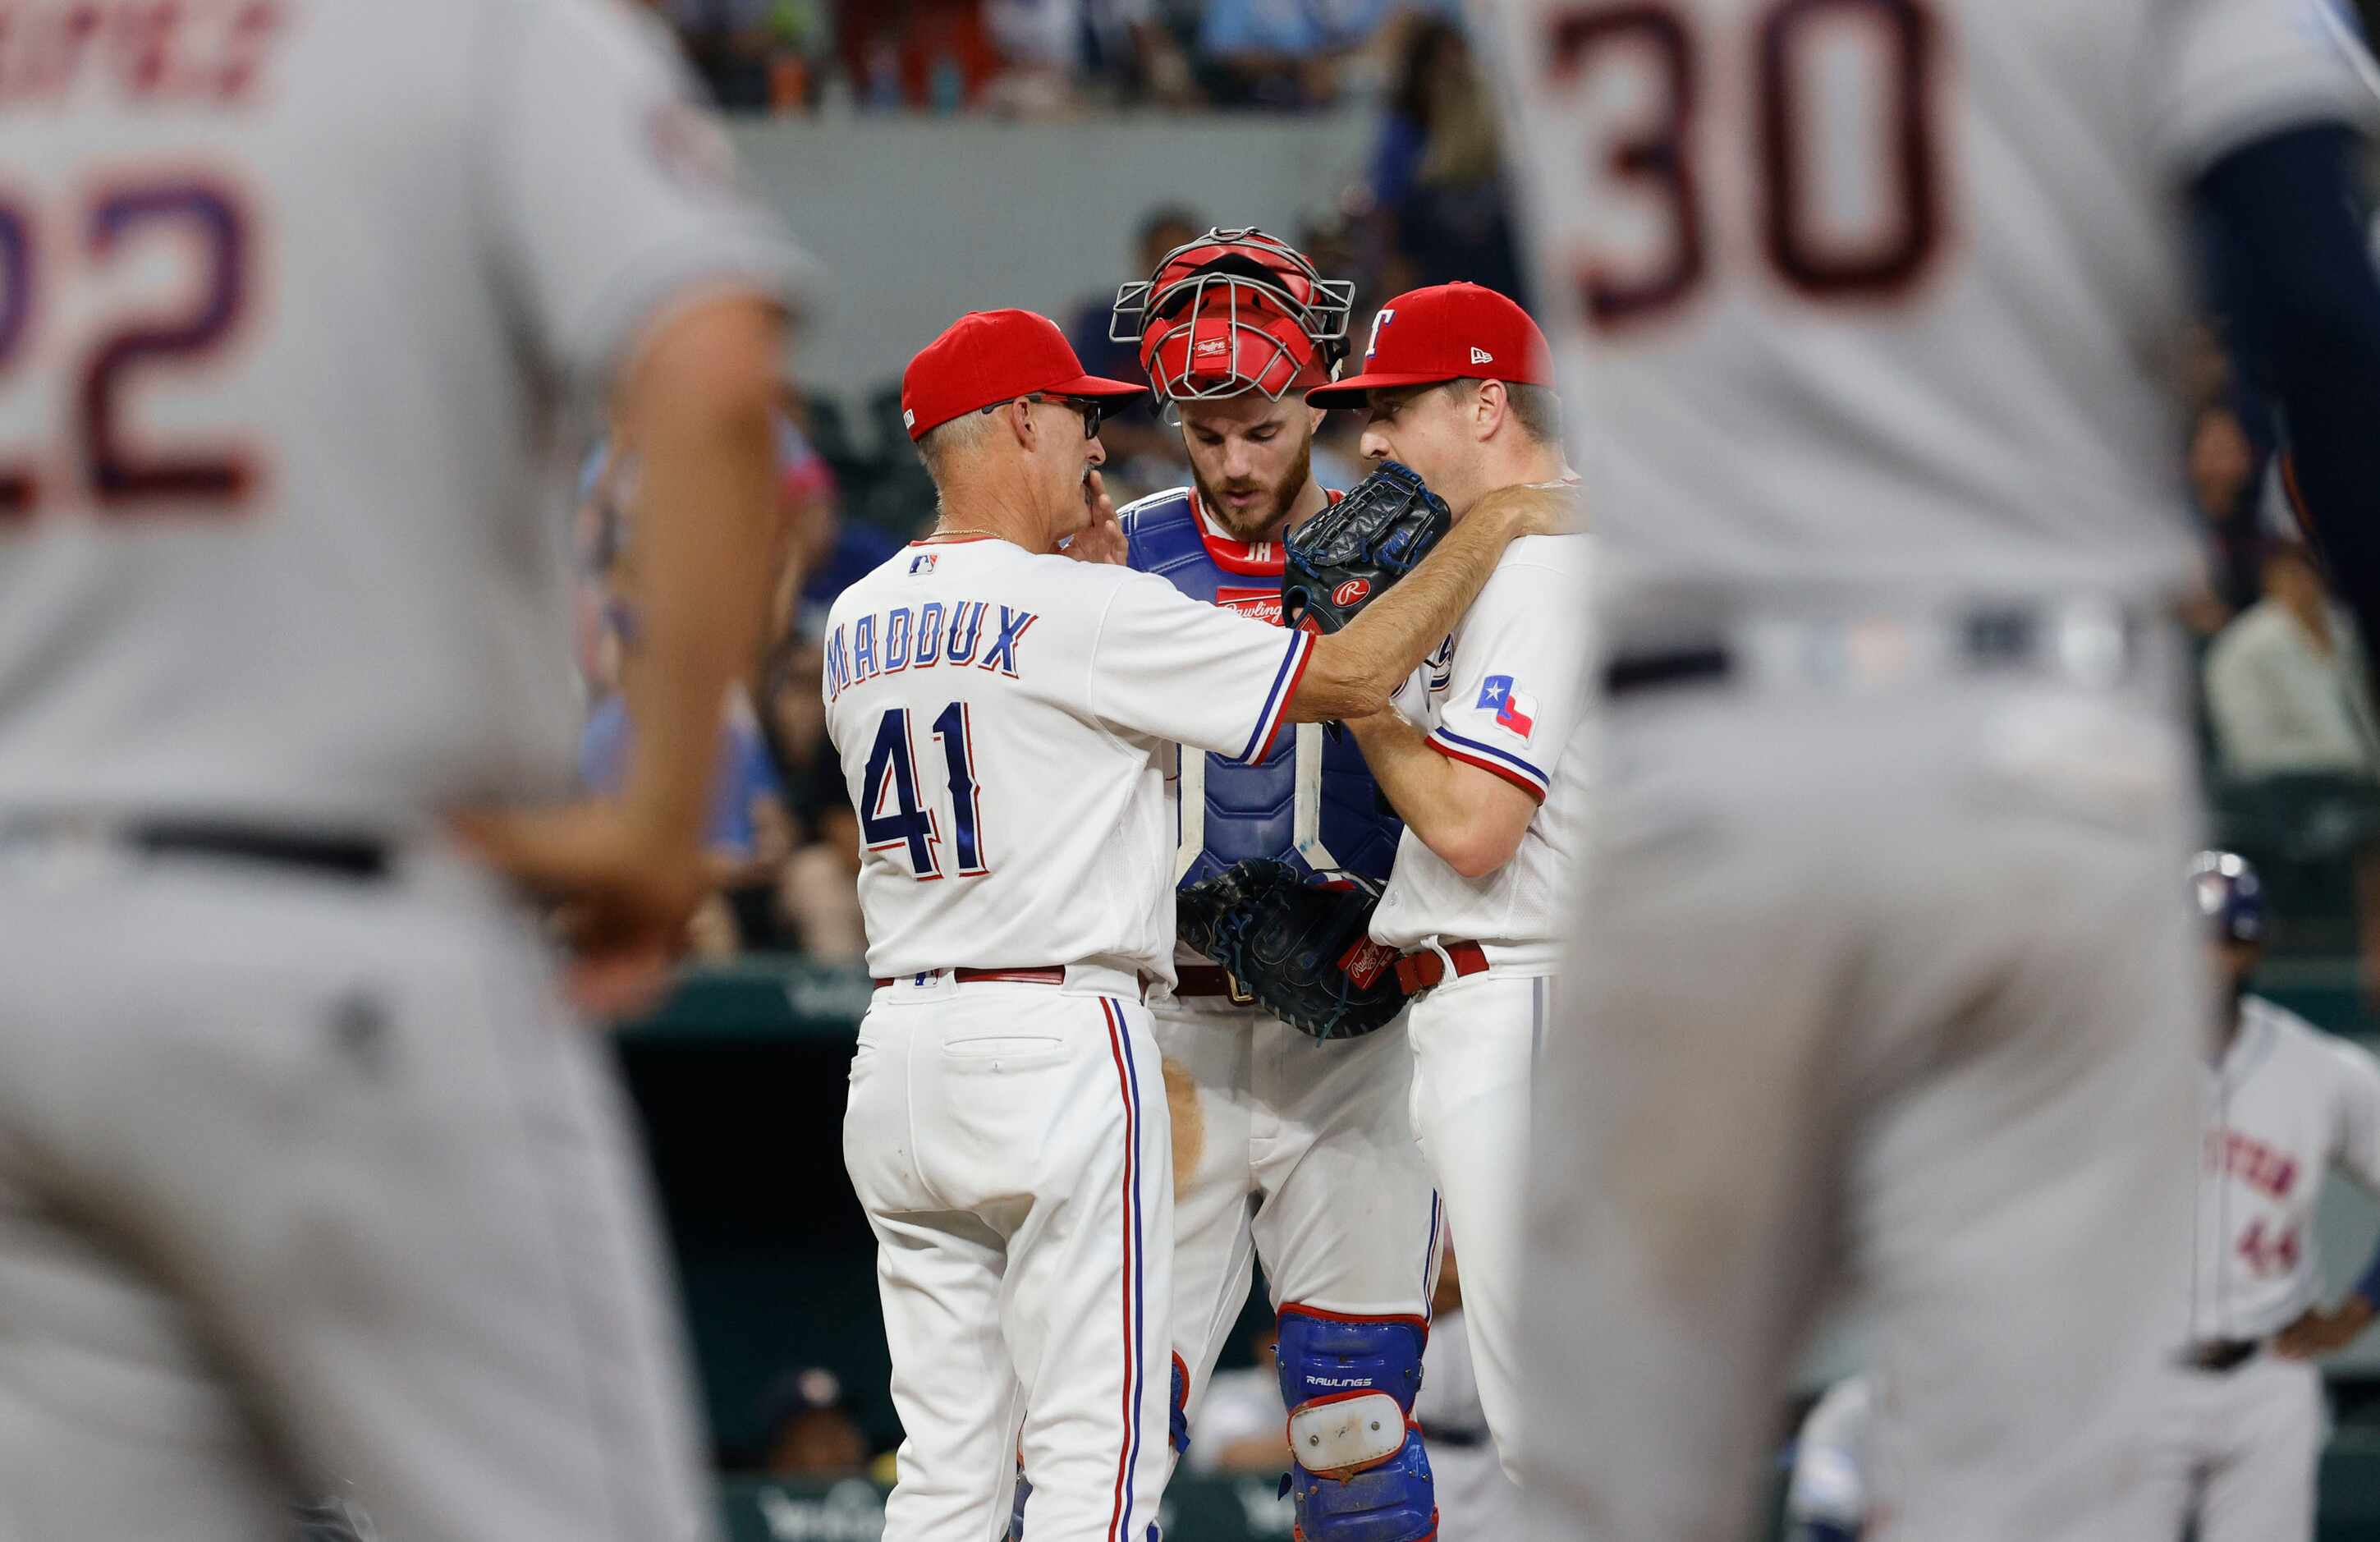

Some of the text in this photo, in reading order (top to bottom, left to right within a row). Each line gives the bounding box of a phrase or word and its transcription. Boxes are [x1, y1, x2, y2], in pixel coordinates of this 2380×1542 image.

[1545, 0, 1944, 330] 30
[0, 168, 261, 513] 2
[1244, 542, 1271, 562] JH
[827, 600, 1039, 704] MADDUX
[1224, 601, 1283, 624] Rawling
[860, 700, 993, 881] 41
[1306, 1375, 1373, 1387] RAWLINGS
